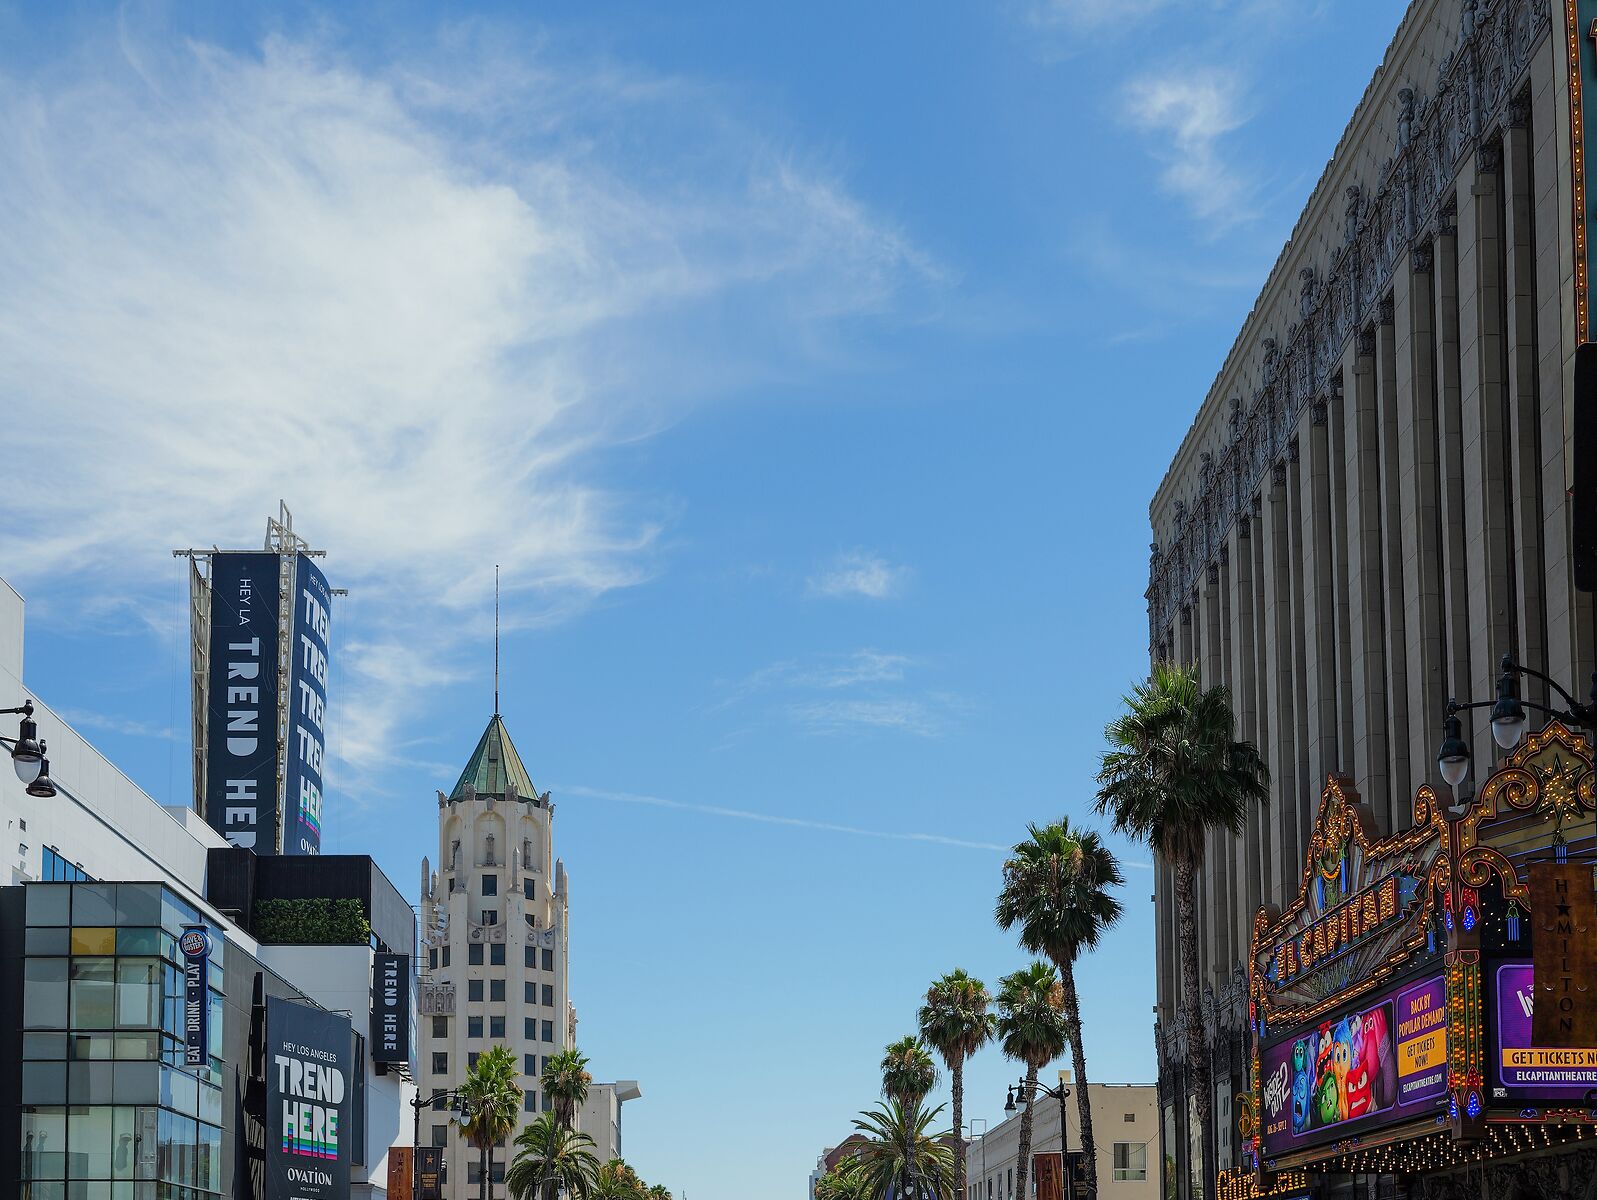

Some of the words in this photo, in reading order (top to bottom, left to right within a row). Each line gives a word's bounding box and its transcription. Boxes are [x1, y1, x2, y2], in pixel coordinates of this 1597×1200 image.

[240, 579, 252, 606] HEY
[240, 609, 252, 626] LA
[226, 637, 260, 757] TREND
[225, 779, 258, 849] HER
[1276, 942, 1297, 980] EL
[1300, 876, 1396, 969] CAPITAN
[187, 962, 200, 987] PLAY
[384, 960, 398, 1006] TREND
[187, 1000, 200, 1032] DRINK
[1410, 997, 1424, 1015] BACK
[1423, 993, 1431, 1009] BY
[384, 1014, 397, 1050] HERE
[1398, 1018, 1421, 1038] POPULAR
[1421, 1006, 1445, 1029] DEMAND!
[187, 1044, 200, 1063] EAT
[283, 1041, 296, 1053] HEY
[297, 1044, 310, 1057] LOS
[310, 1049, 337, 1063] ANGELES
[1407, 1043, 1416, 1058] GET
[1416, 1037, 1435, 1054] TICKETS
[1414, 1054, 1429, 1069] NOW!
[1512, 1052, 1534, 1064] GET
[1538, 1052, 1584, 1064] TICKETS
[274, 1054, 345, 1104] TREND
[282, 1099, 339, 1161] HERE
